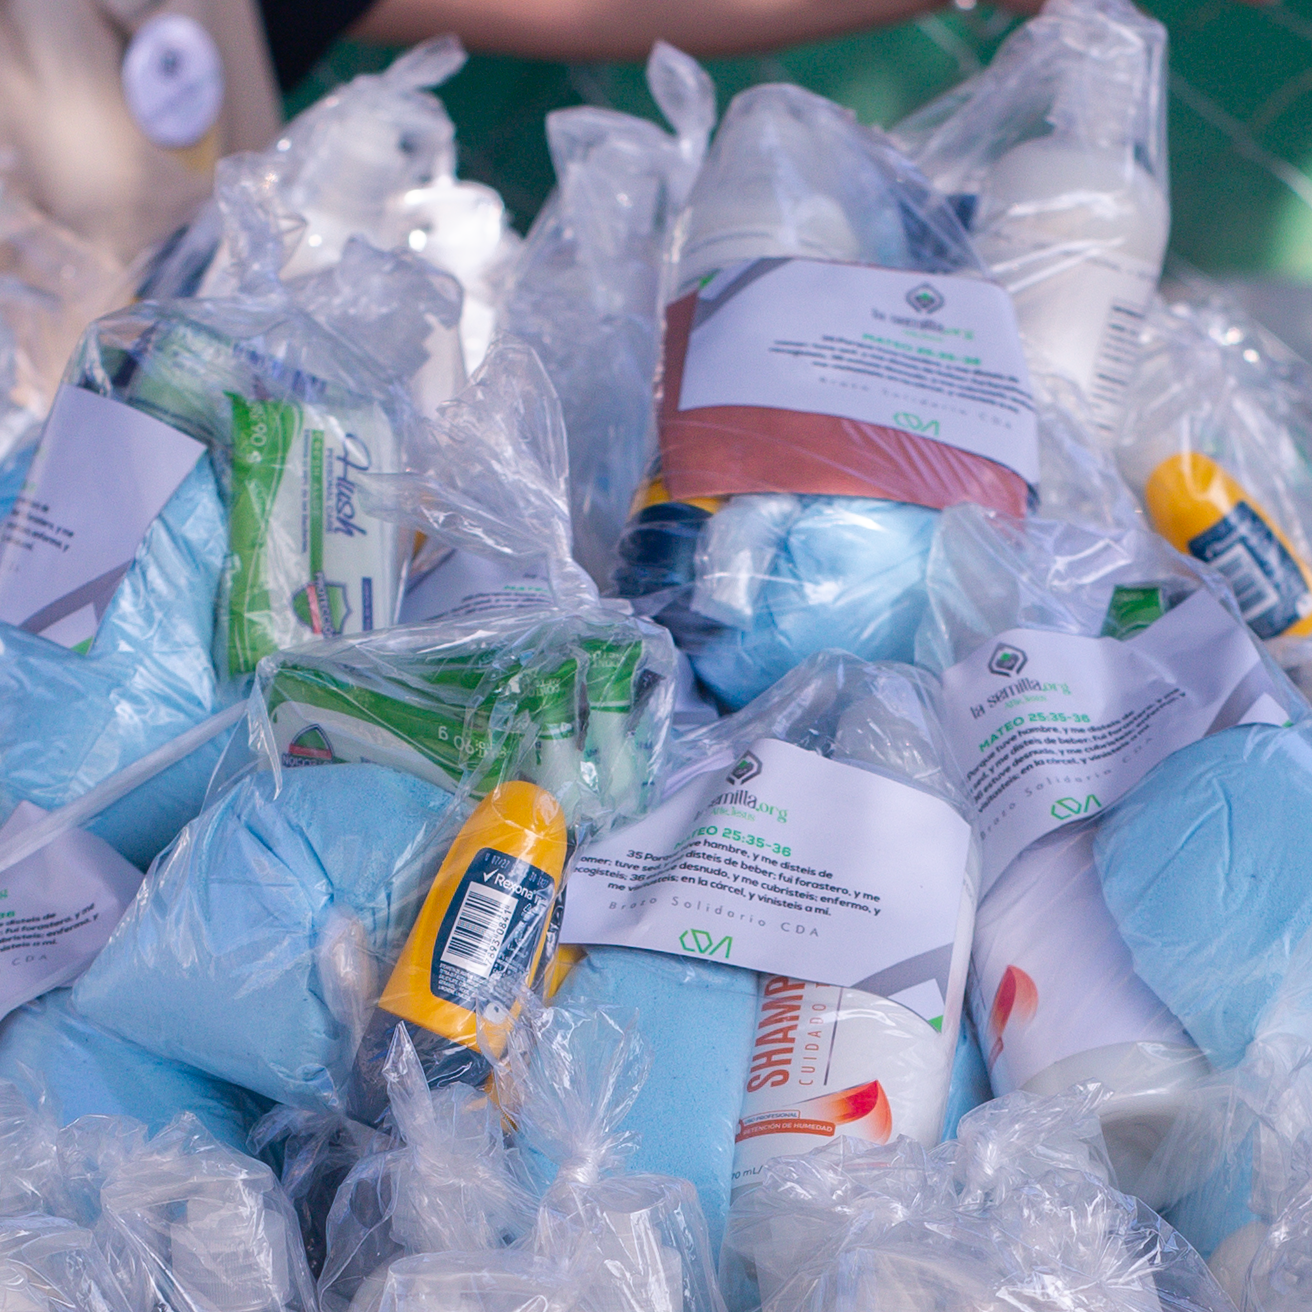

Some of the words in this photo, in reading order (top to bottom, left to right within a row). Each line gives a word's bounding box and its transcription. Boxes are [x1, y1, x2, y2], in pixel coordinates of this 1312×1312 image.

[722, 828, 791, 857] 25:35-36
[672, 896, 766, 927] Solidario
[780, 922, 819, 937] CDA
